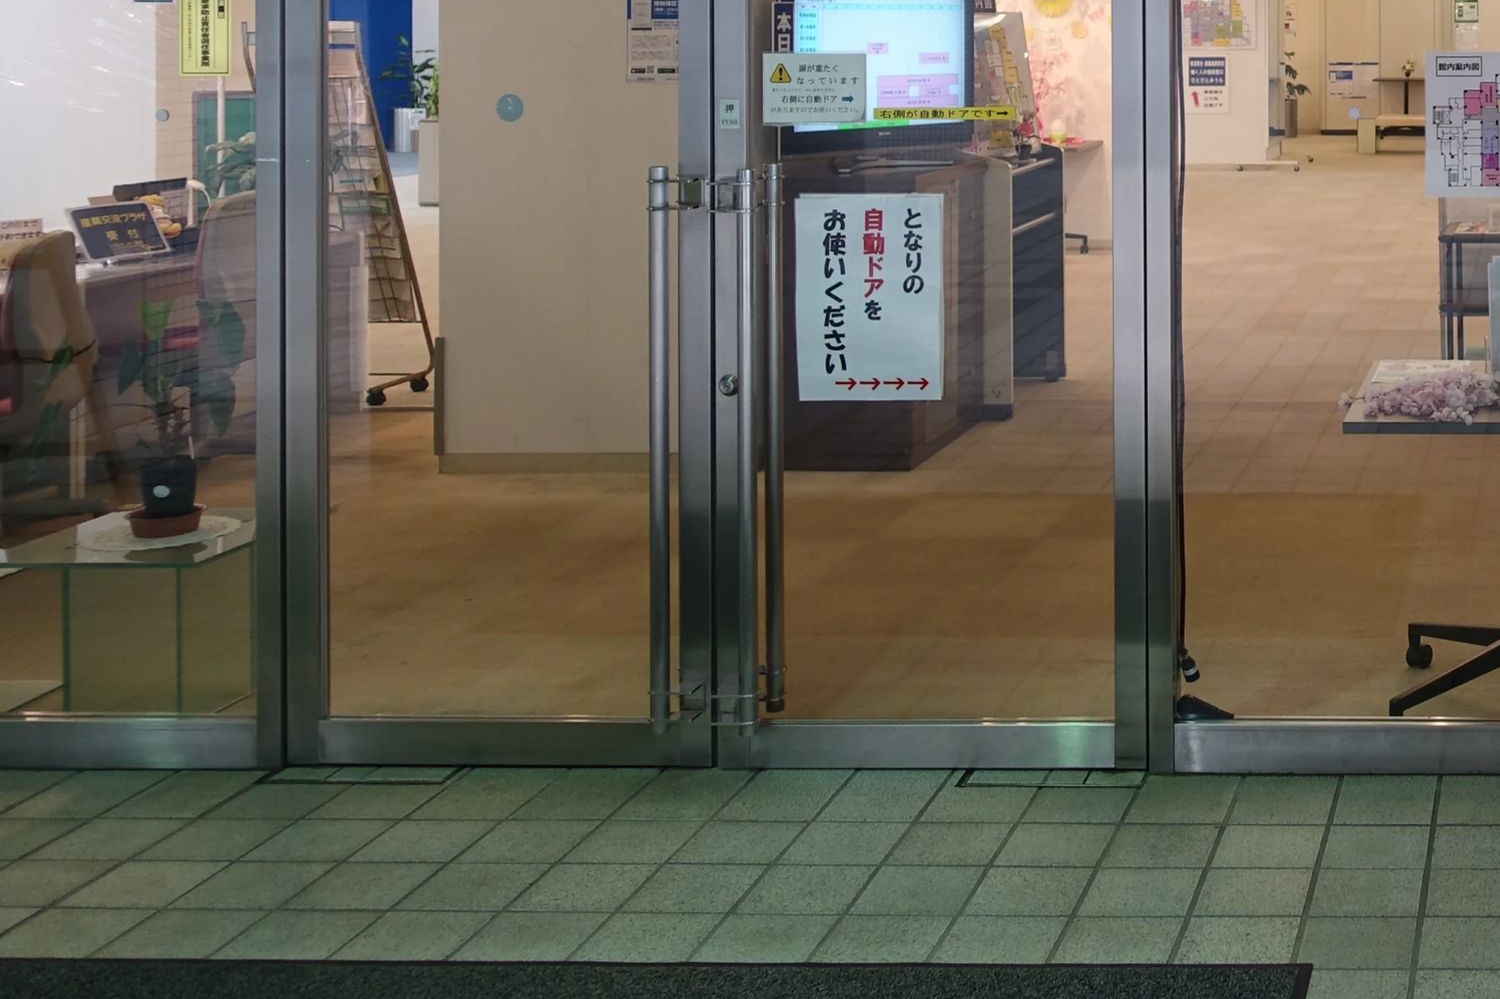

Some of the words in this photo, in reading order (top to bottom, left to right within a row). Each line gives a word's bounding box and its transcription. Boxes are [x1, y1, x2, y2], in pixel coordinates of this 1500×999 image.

[1438, 63, 1480, 71] 館内案内図
[796, 77, 859, 85] なっています
[781, 95, 838, 103] 右側に自動ドア
[725, 104, 735, 113] 押
[880, 109, 996, 119] 右側が自動ドアです
[902, 208, 925, 294] となりの
[863, 208, 885, 321] 自動ドアを
[823, 209, 847, 375] お使いください
